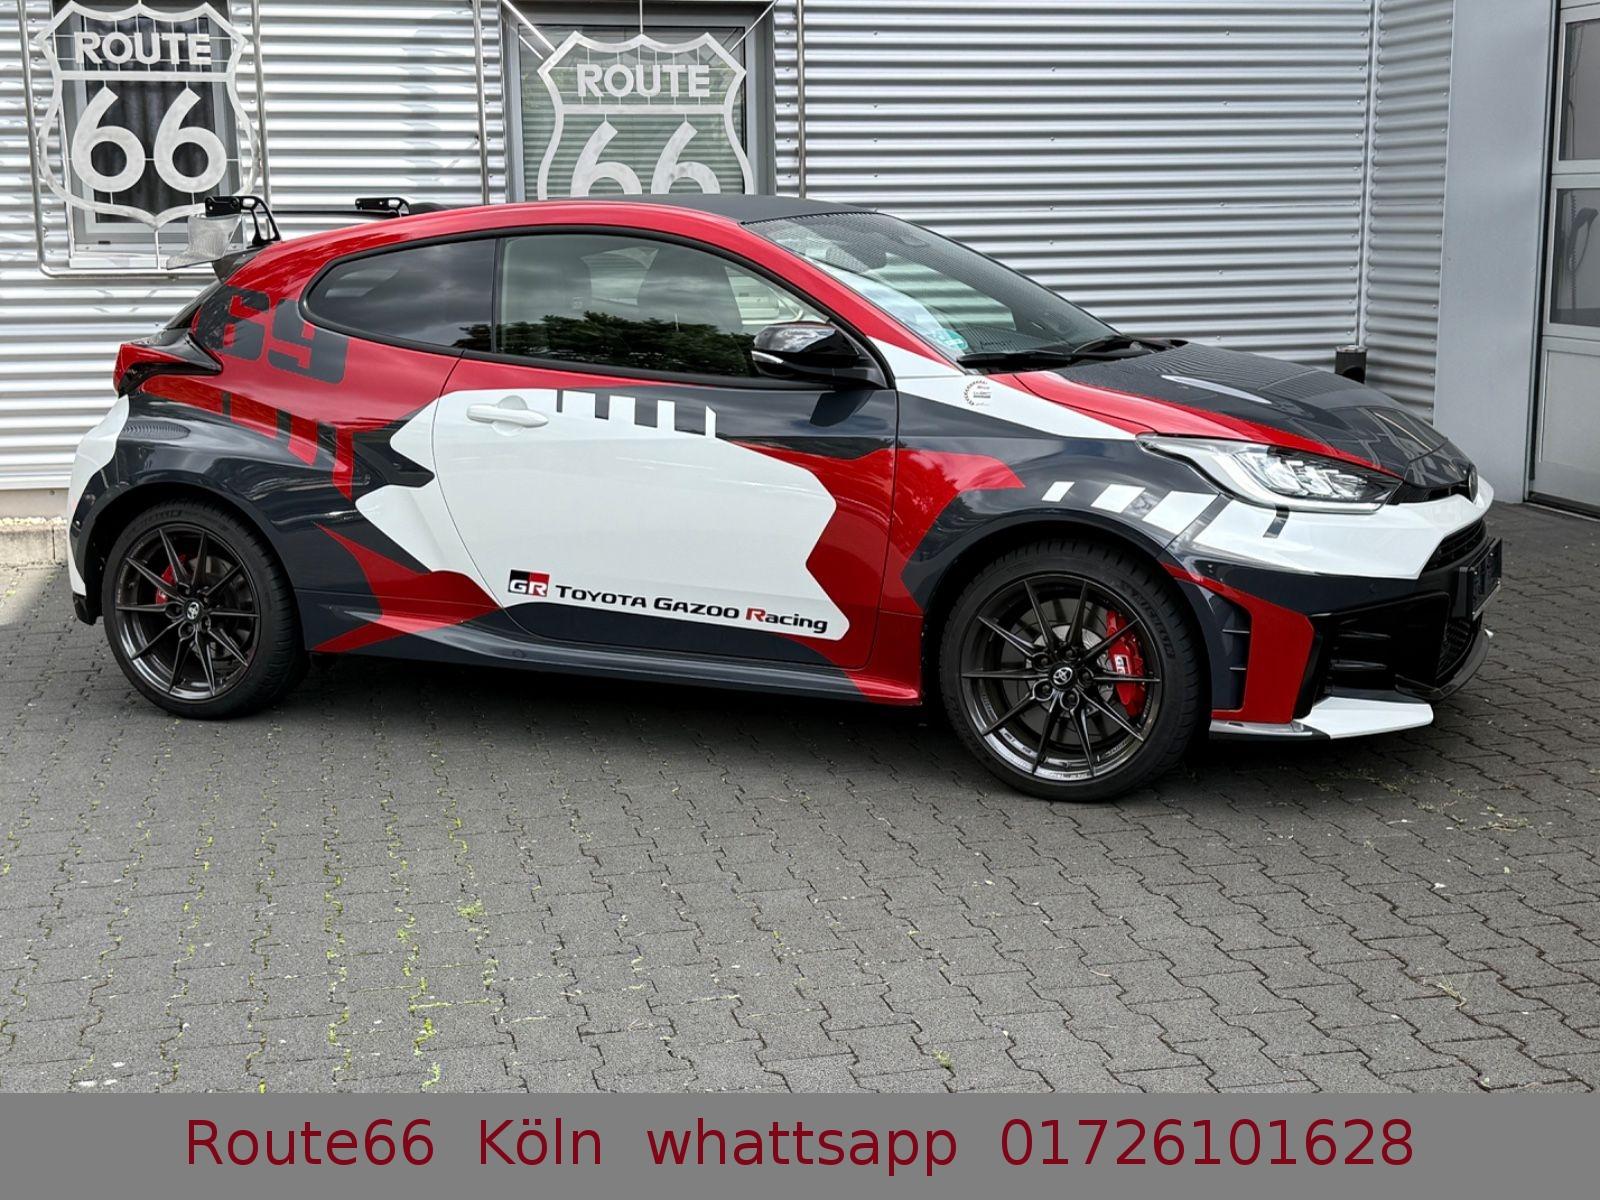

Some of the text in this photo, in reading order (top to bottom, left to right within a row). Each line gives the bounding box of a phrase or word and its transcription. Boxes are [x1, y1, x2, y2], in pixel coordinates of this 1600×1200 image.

[74, 31, 212, 65] ROUTE
[576, 63, 711, 98] ROUTE
[71, 86, 227, 193] 66
[570, 121, 722, 197] 66
[509, 577, 828, 634] GR TOYOTA GAZOO Racing
